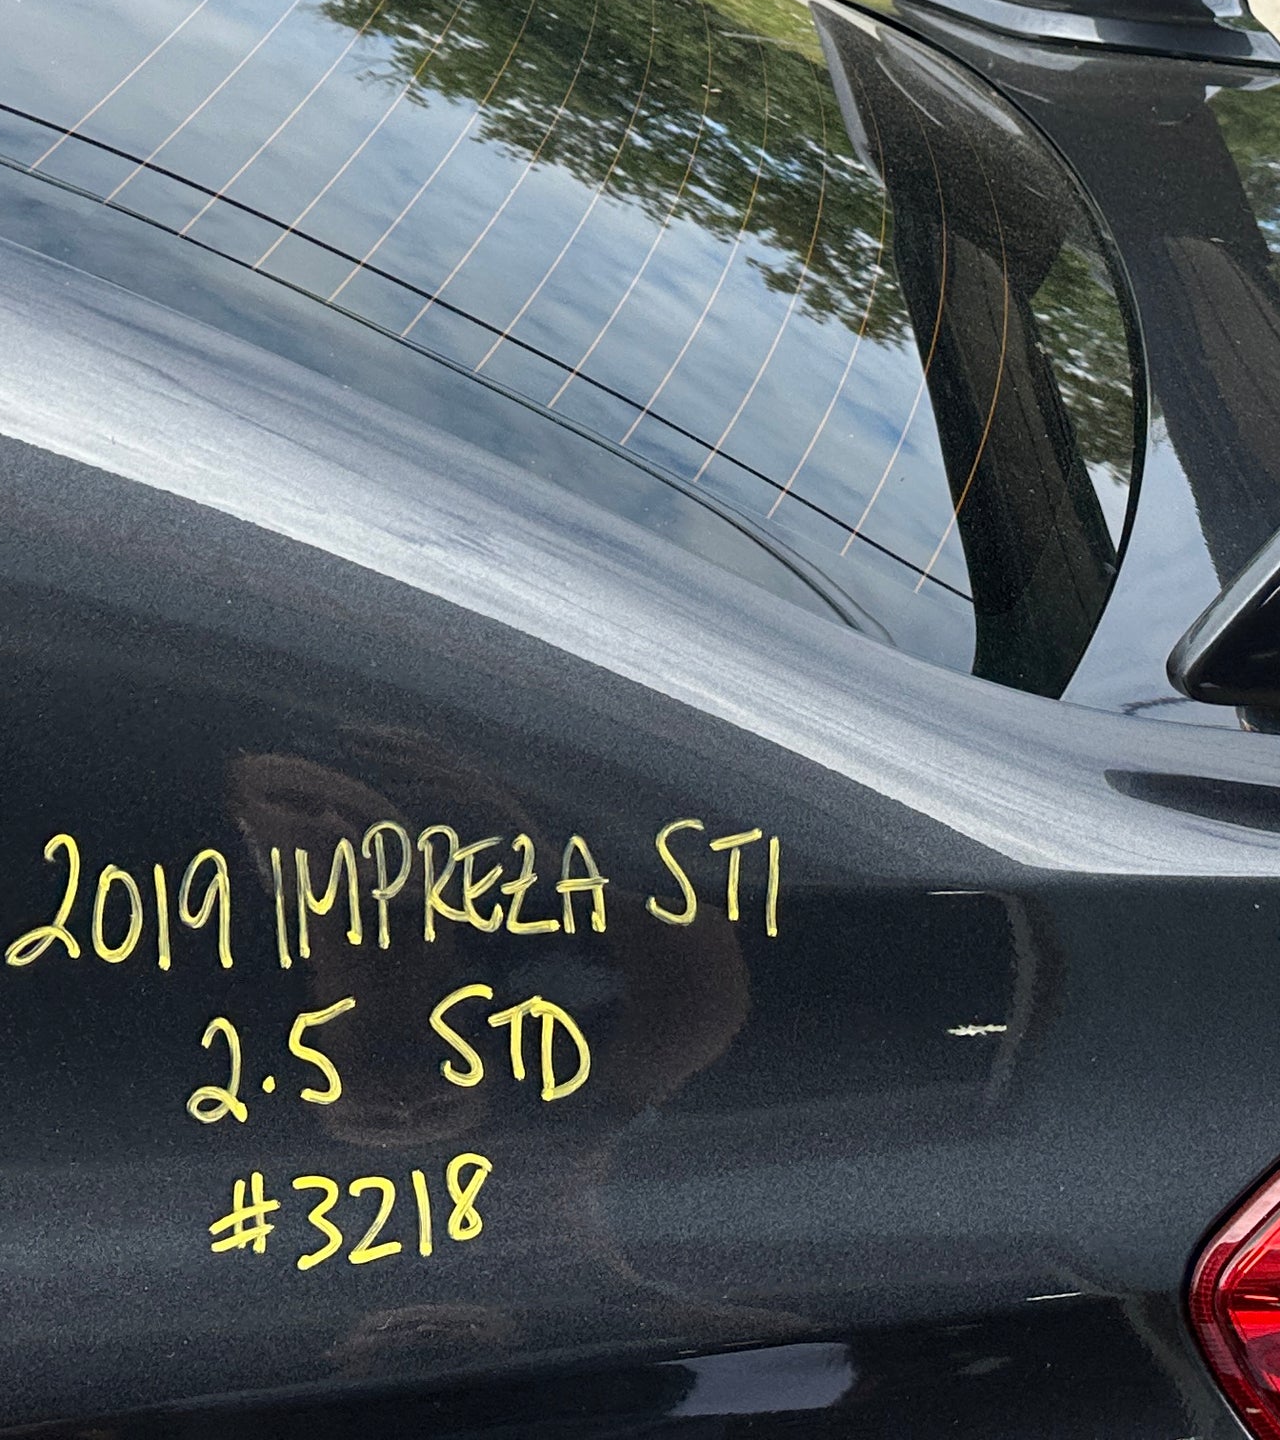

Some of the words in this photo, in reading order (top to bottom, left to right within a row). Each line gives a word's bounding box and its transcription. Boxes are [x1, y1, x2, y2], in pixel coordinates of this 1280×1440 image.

[5, 833, 234, 971] 2019
[270, 820, 609, 969] IMPREZA
[648, 819, 780, 938] STI
[187, 997, 357, 1123] 2.5
[428, 983, 592, 1102] STD
[208, 1152, 494, 1271] #3218
